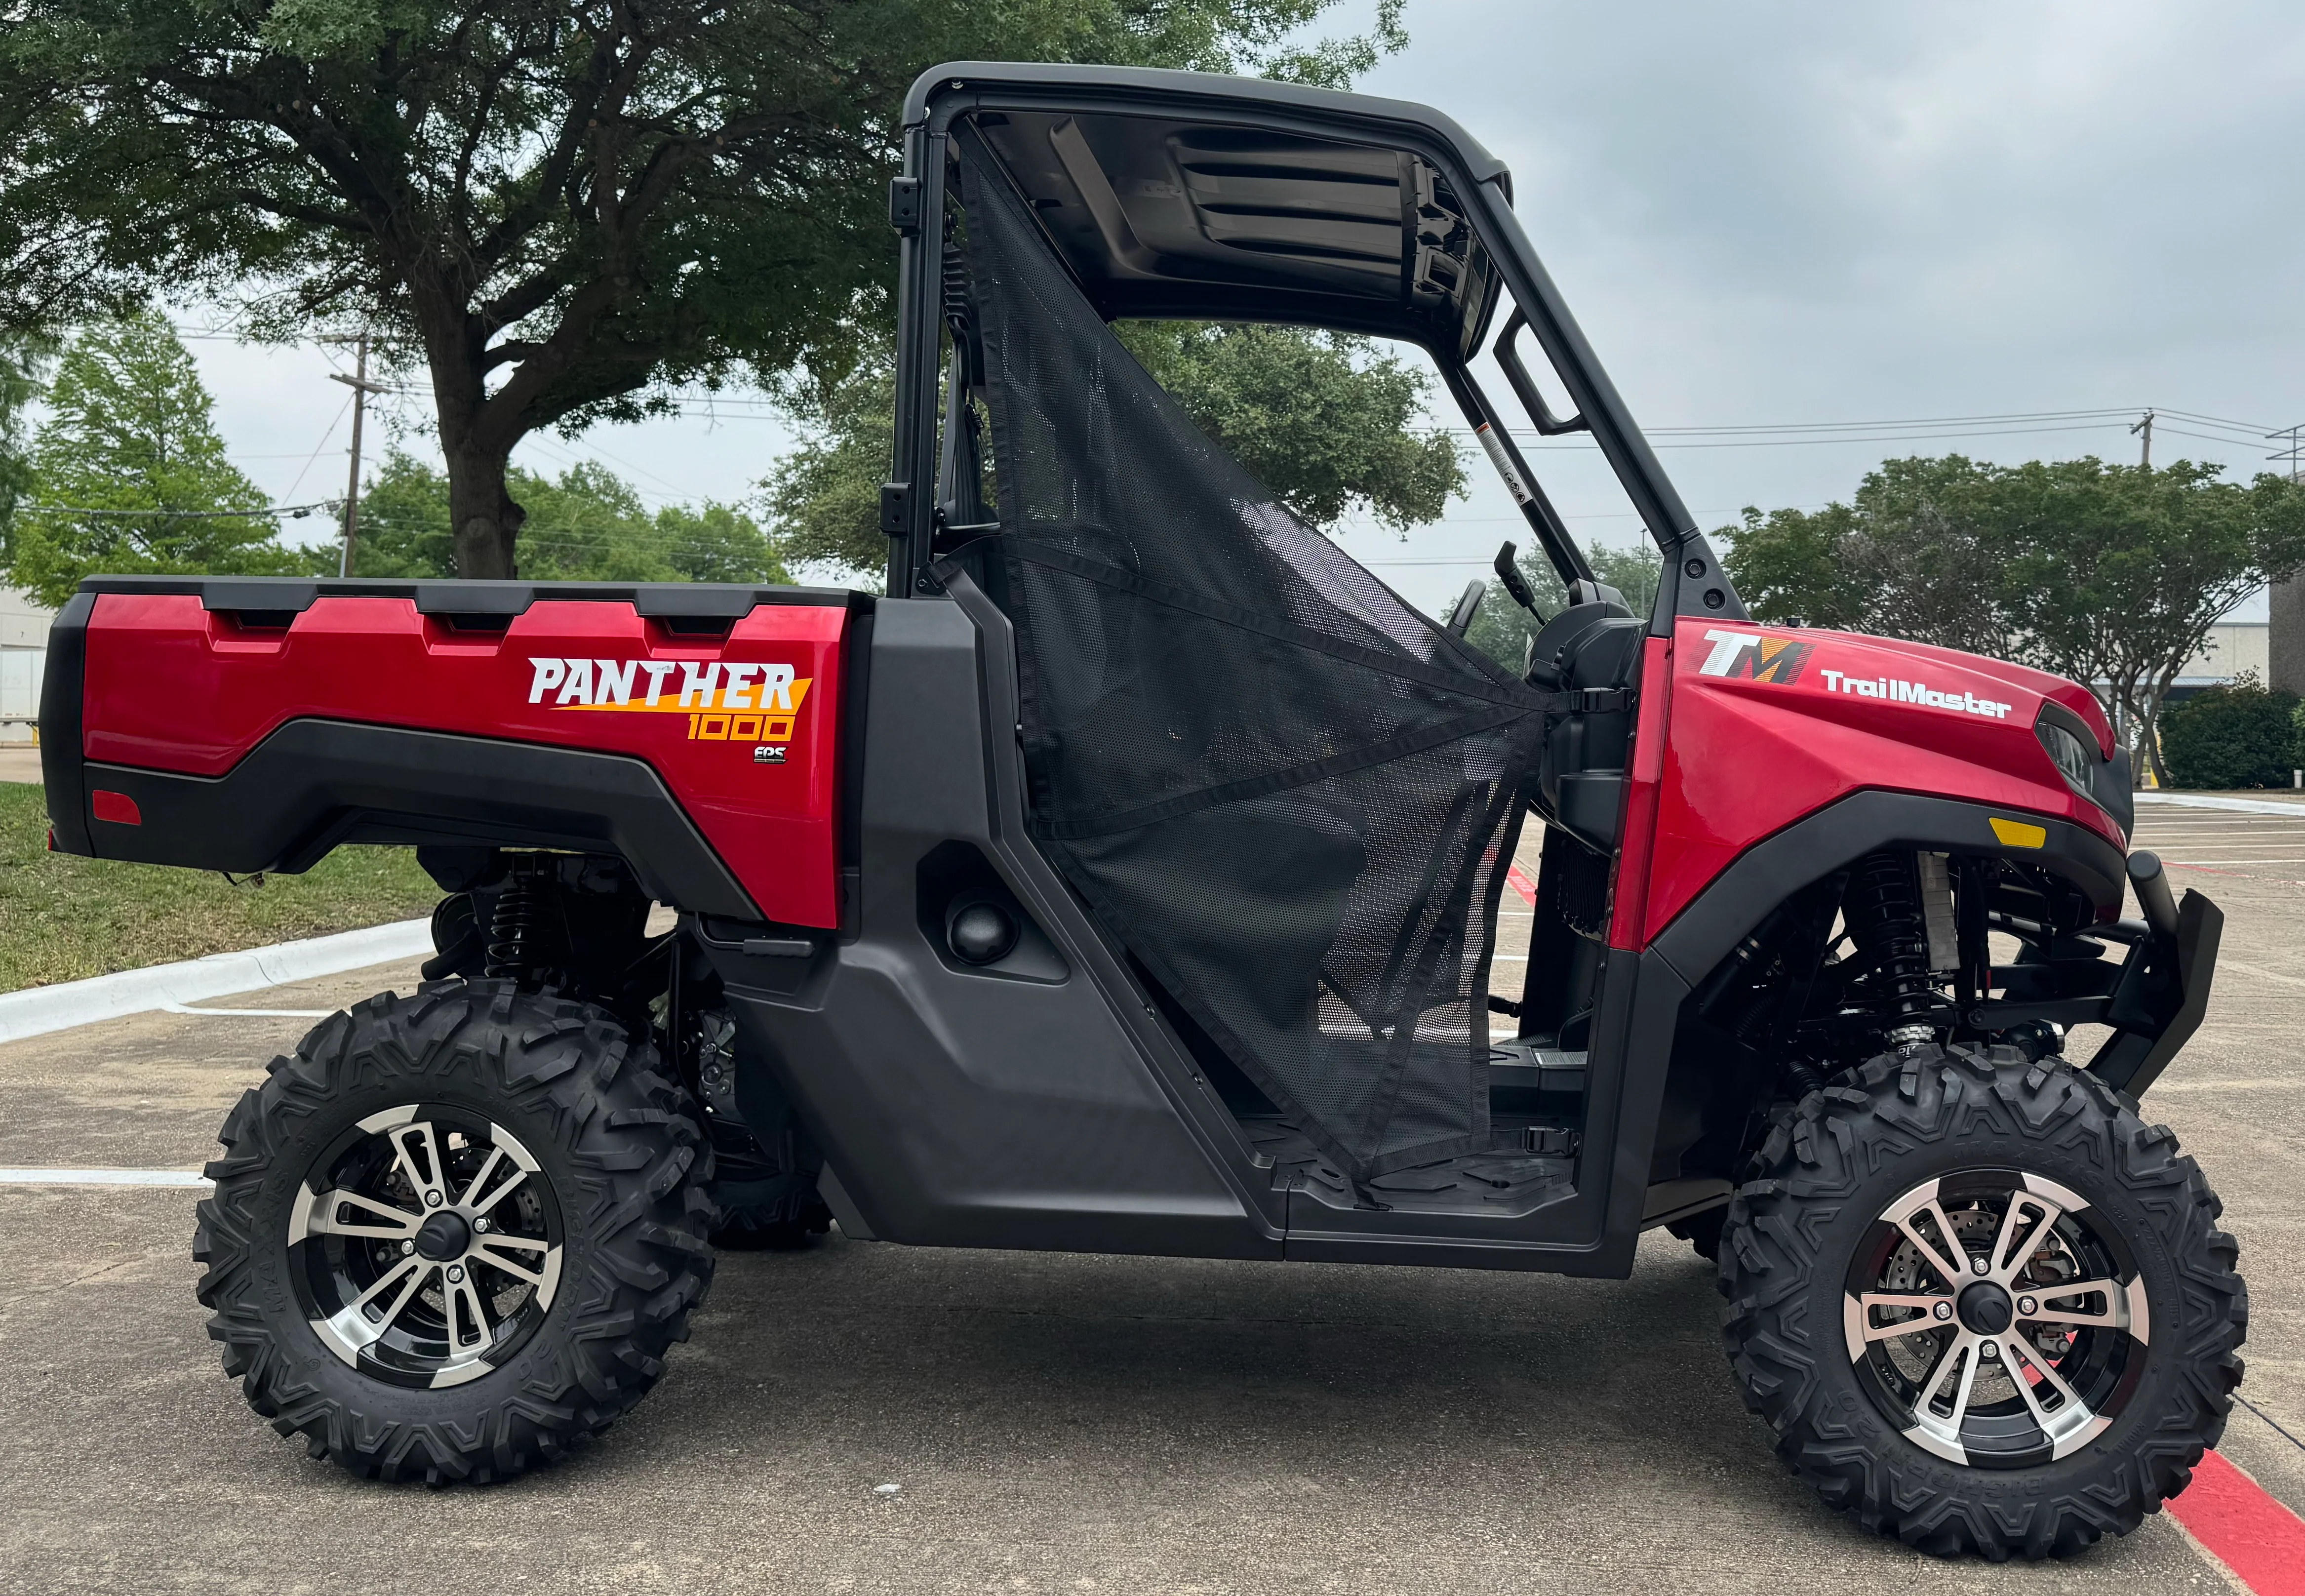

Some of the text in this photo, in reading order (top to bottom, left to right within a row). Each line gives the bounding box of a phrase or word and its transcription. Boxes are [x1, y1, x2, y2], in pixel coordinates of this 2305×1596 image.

[1698, 629, 1811, 684] TM
[527, 657, 795, 710] PANTHER
[1821, 669, 2012, 719] TrailMaster
[687, 714, 795, 742] 1000
[754, 746, 787, 758] EPS
[1949, 1139, 2106, 1188] MAXXIS
[257, 1166, 289, 1313] MAXXIS
[1878, 1441, 2047, 1498] BIGHORN
